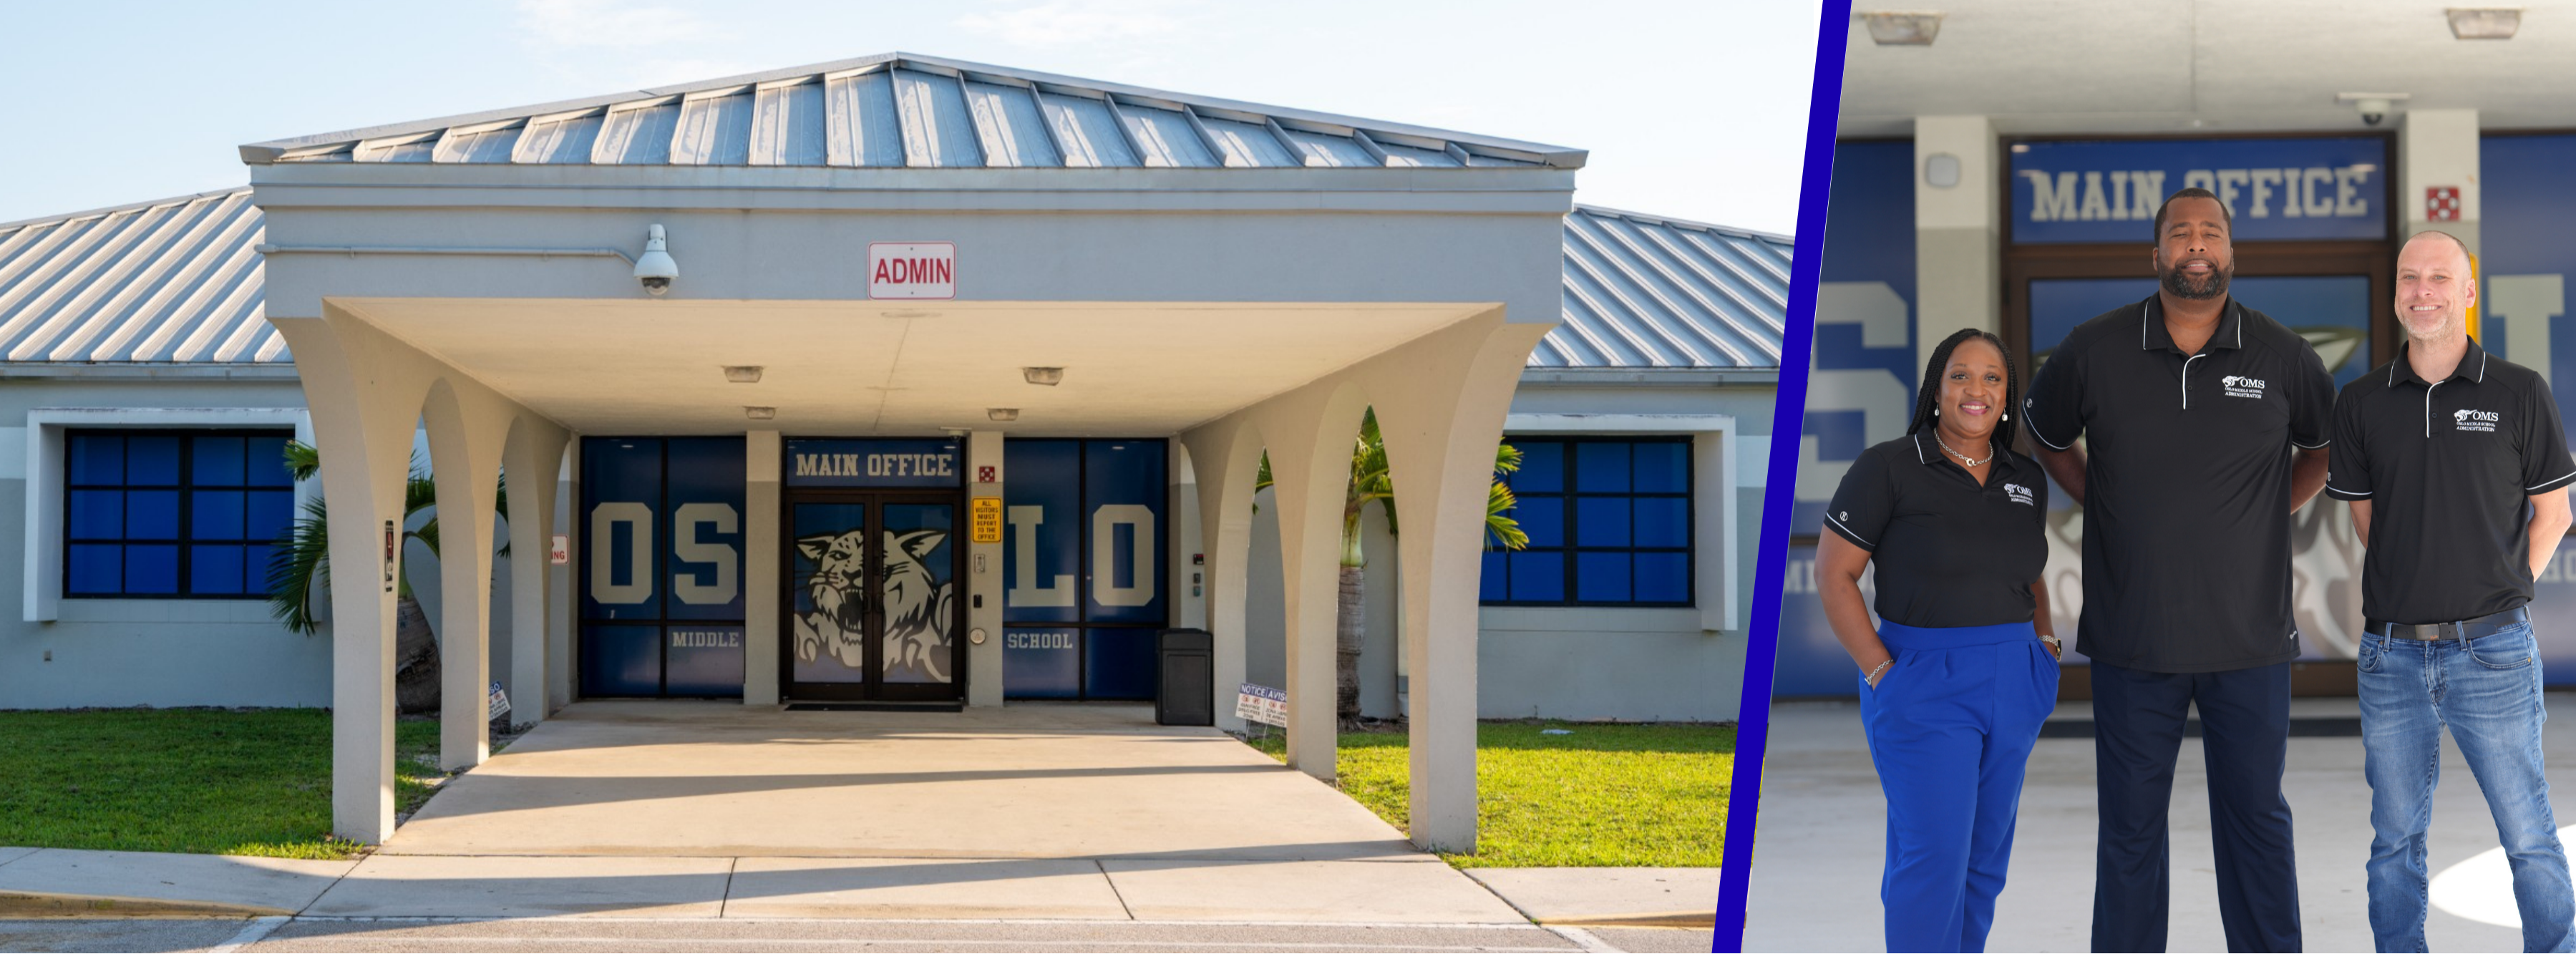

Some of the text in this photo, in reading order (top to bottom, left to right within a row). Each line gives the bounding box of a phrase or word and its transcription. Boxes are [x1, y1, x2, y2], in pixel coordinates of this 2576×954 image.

[2029, 171, 2166, 221] MAIN
[874, 258, 951, 284] ADMIN
[2240, 377, 2265, 389] OMS
[2472, 411, 2499, 422] OMS
[796, 454, 953, 477] MAIN OFFICE
[673, 632, 739, 647] MIDDLE
[1007, 633, 1073, 649] SCHOOL
[1241, 684, 1266, 697] NOTICE
[1268, 689, 1287, 702] AVIS
